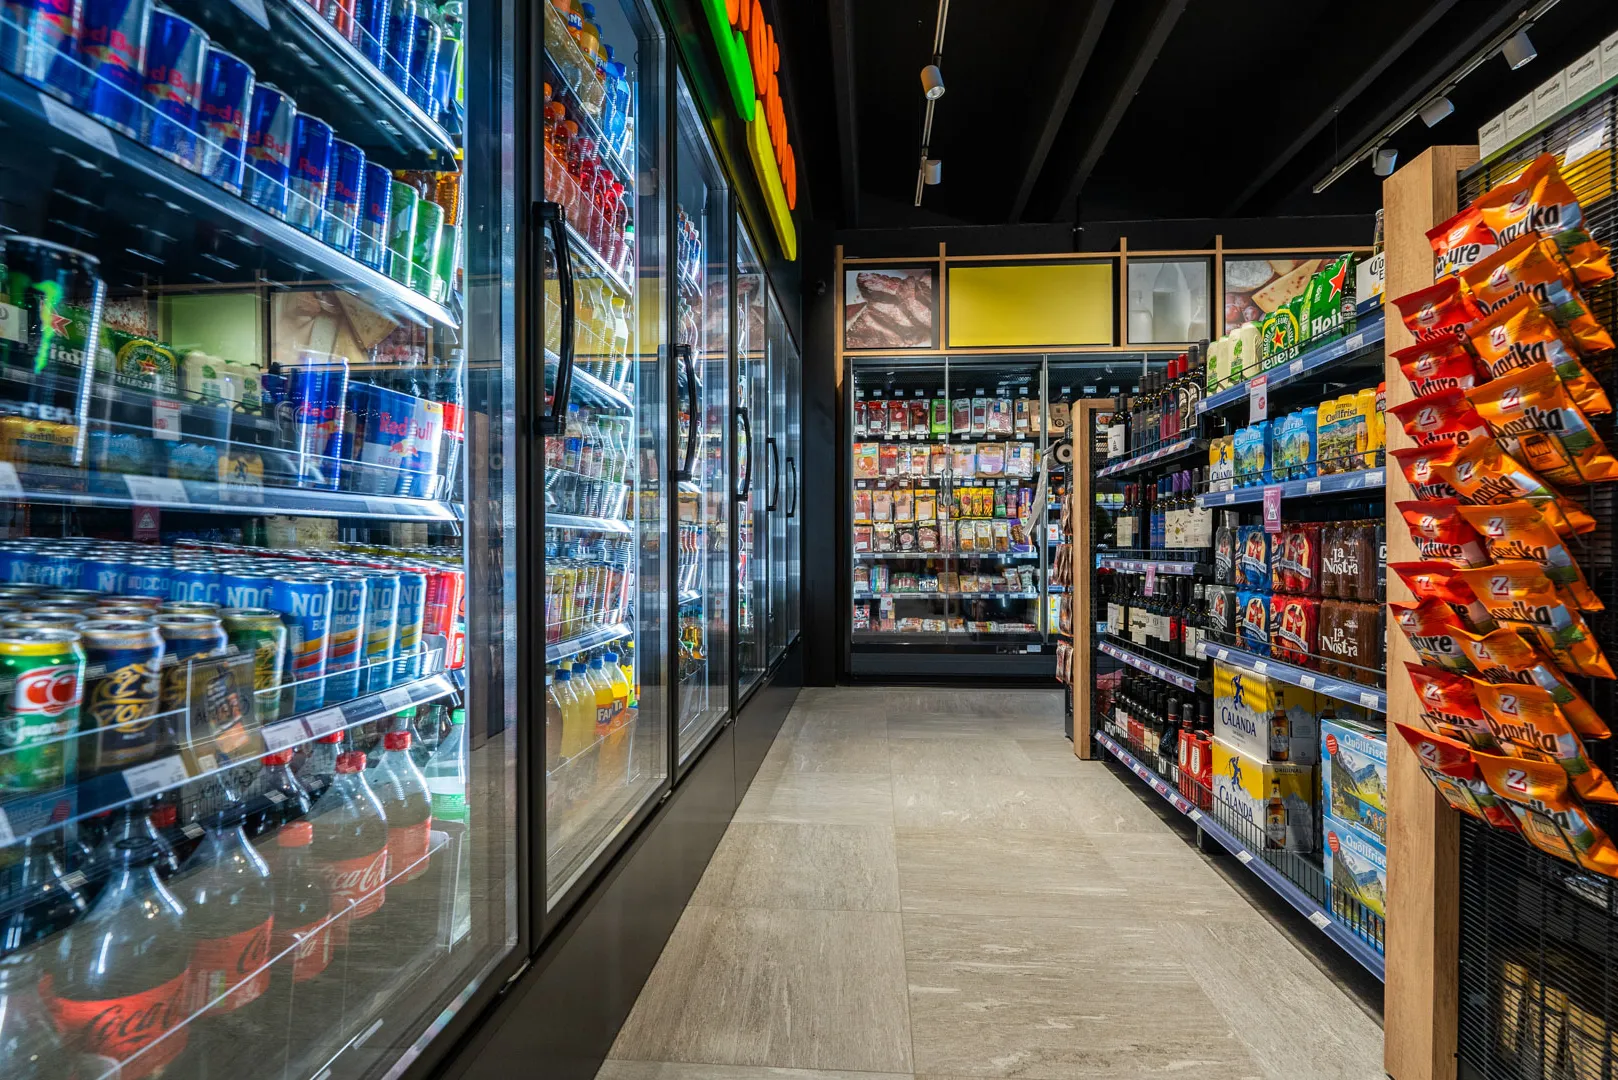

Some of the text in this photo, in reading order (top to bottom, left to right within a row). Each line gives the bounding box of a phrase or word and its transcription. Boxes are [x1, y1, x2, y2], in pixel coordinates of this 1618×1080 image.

[1501, 387, 1520, 410] Z
[379, 412, 408, 436] Red
[1418, 407, 1437, 427] Z
[1488, 517, 1504, 536] Z
[1333, 547, 1344, 562] La
[1323, 557, 1358, 576] Nostra
[1491, 576, 1509, 595] Z
[1333, 627, 1344, 642] La
[1322, 635, 1358, 657] Nostra
[1425, 683, 1441, 702] Z
[1500, 694, 1519, 716] Z
[1221, 706, 1257, 738] CALANDA
[1482, 709, 1558, 753] Paprika
[1506, 769, 1527, 792] Z
[1219, 785, 1253, 824] CALANDA
